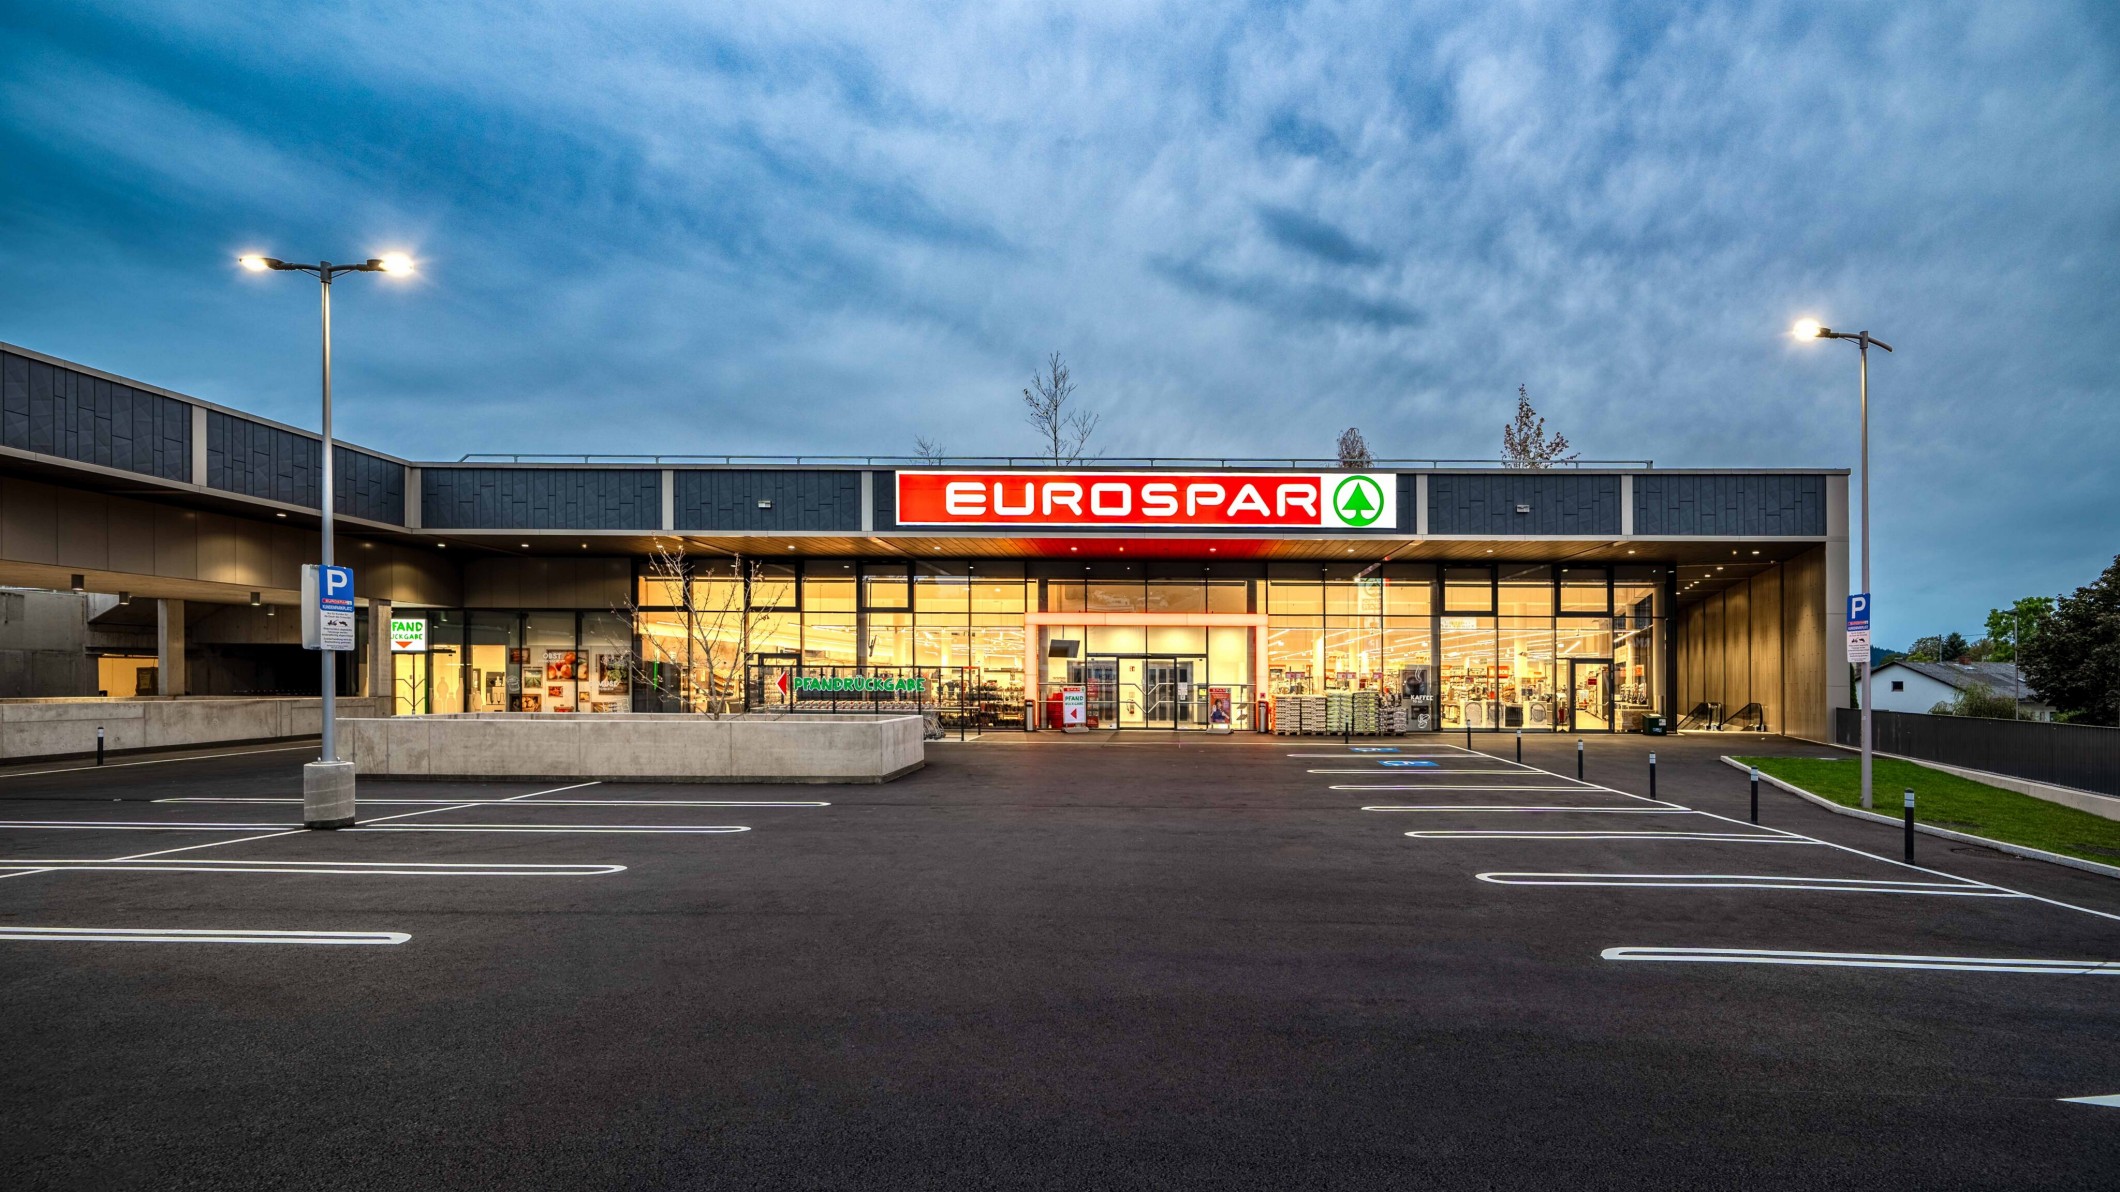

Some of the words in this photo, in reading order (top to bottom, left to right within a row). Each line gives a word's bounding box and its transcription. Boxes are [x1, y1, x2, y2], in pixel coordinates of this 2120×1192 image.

[945, 482, 1317, 517] EUROSPAR
[327, 569, 347, 595] P
[1851, 597, 1866, 618] P
[392, 621, 423, 632] FAND
[794, 674, 926, 692] PFANDRÜCKGABE
